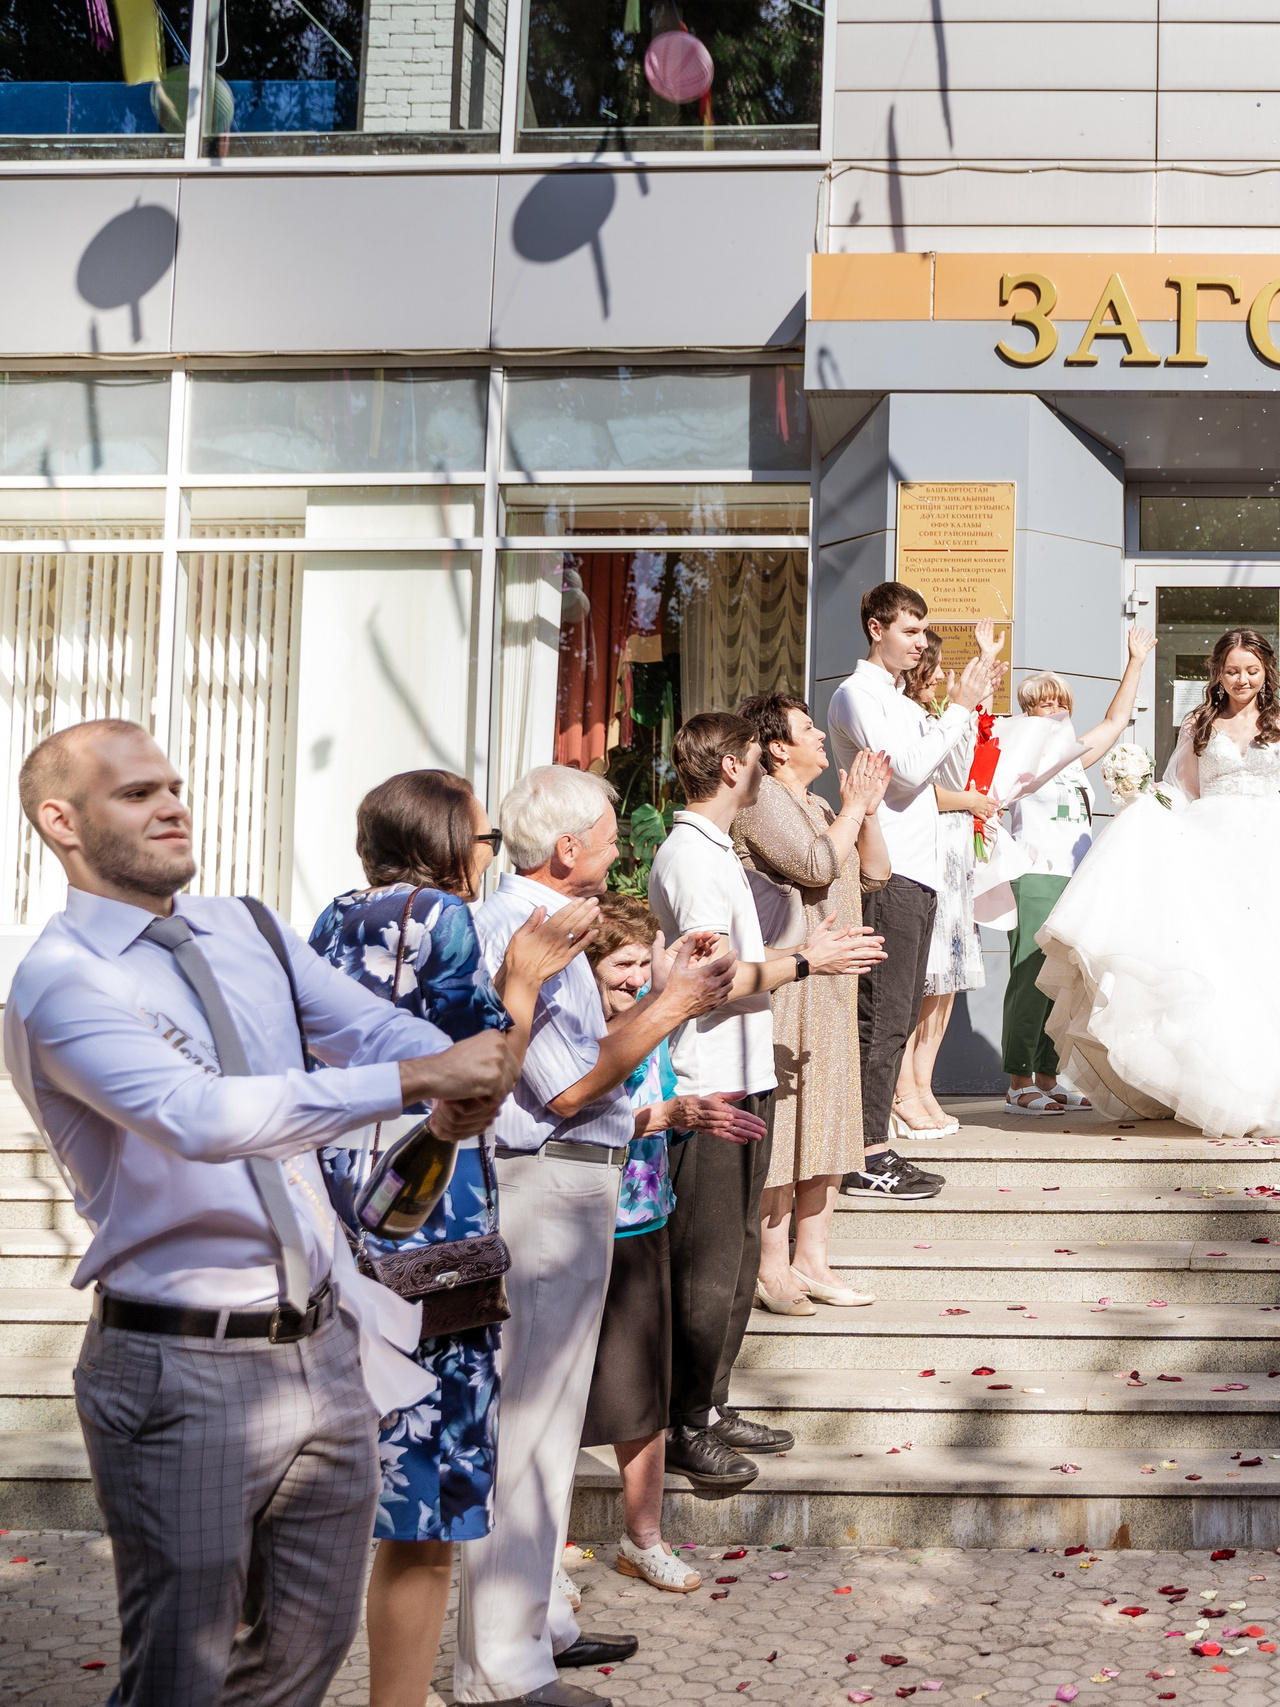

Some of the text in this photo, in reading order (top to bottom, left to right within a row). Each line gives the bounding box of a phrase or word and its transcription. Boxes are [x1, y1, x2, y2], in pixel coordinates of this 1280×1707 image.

[905, 556, 972, 564] Государственный
[905, 566, 1007, 574] Республики Башкортостан
[929, 606, 957, 614] района
[965, 606, 981, 614] Уфа
